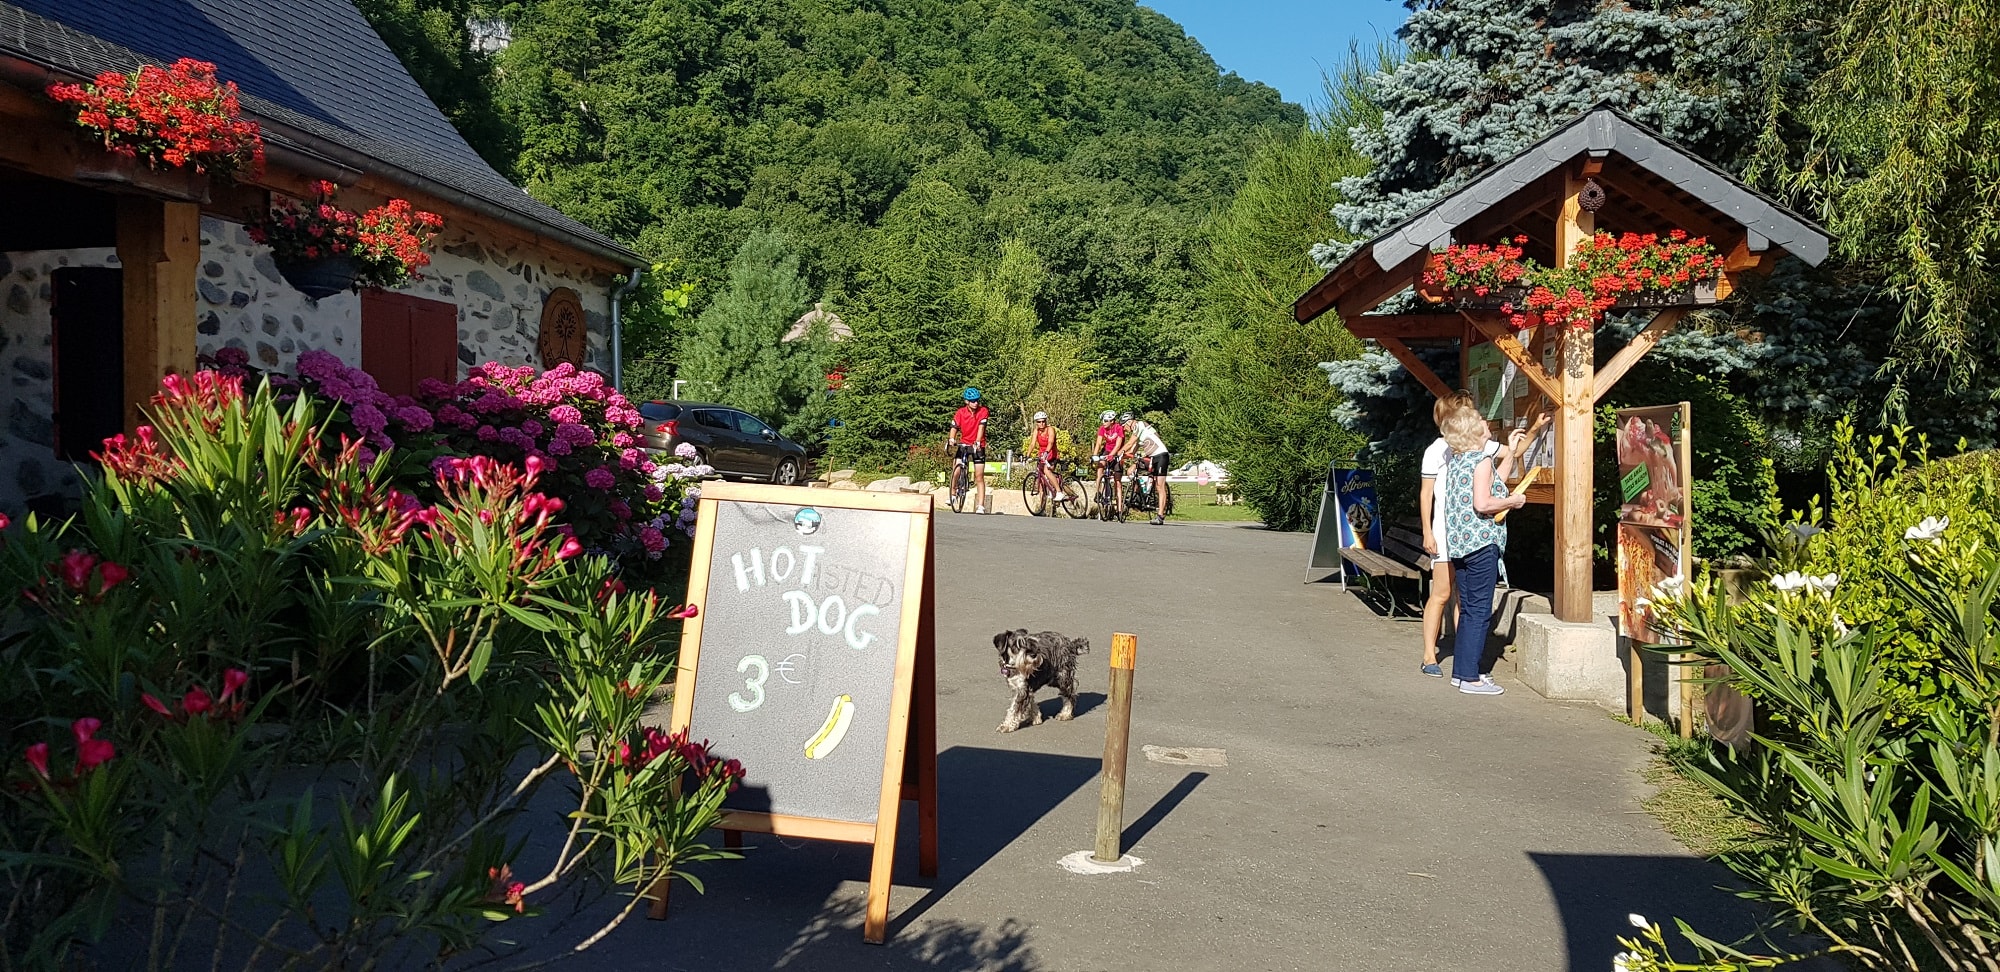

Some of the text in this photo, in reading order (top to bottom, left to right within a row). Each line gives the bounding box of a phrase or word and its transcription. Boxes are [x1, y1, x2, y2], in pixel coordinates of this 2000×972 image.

[731, 544, 825, 594] HOT
[782, 589, 880, 651] DOG
[728, 653, 807, 713] 3 €
